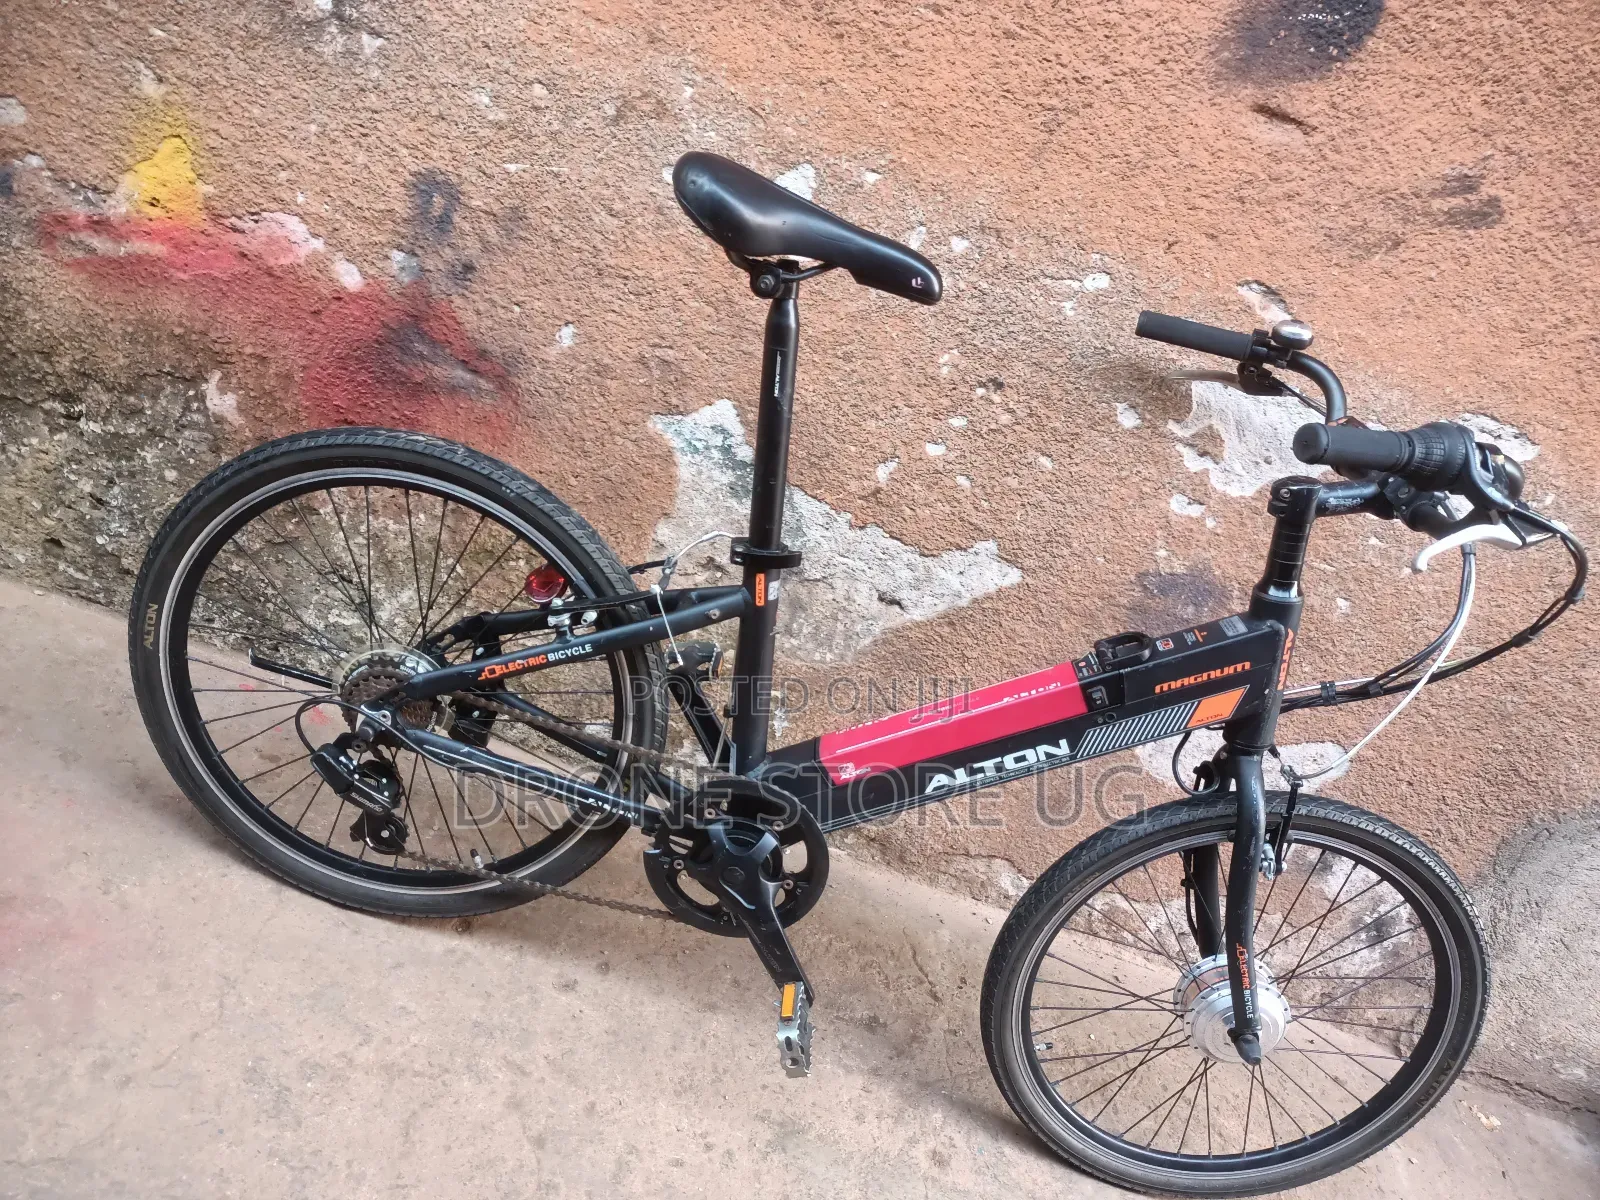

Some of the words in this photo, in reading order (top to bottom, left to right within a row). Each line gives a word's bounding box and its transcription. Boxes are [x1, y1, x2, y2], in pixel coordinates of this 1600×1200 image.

[143, 603, 159, 650] ALTON
[496, 654, 547, 675] ELECTRIC
[548, 643, 593, 662] BICYCLE
[1277, 628, 1294, 690] ALTON
[1154, 661, 1251, 694] MAGNUM
[1196, 713, 1223, 723] ALTON
[924, 738, 1071, 794] ALTON
[1239, 956, 1251, 989] ELECTRIC
[1243, 989, 1254, 1019] BICYCLE
